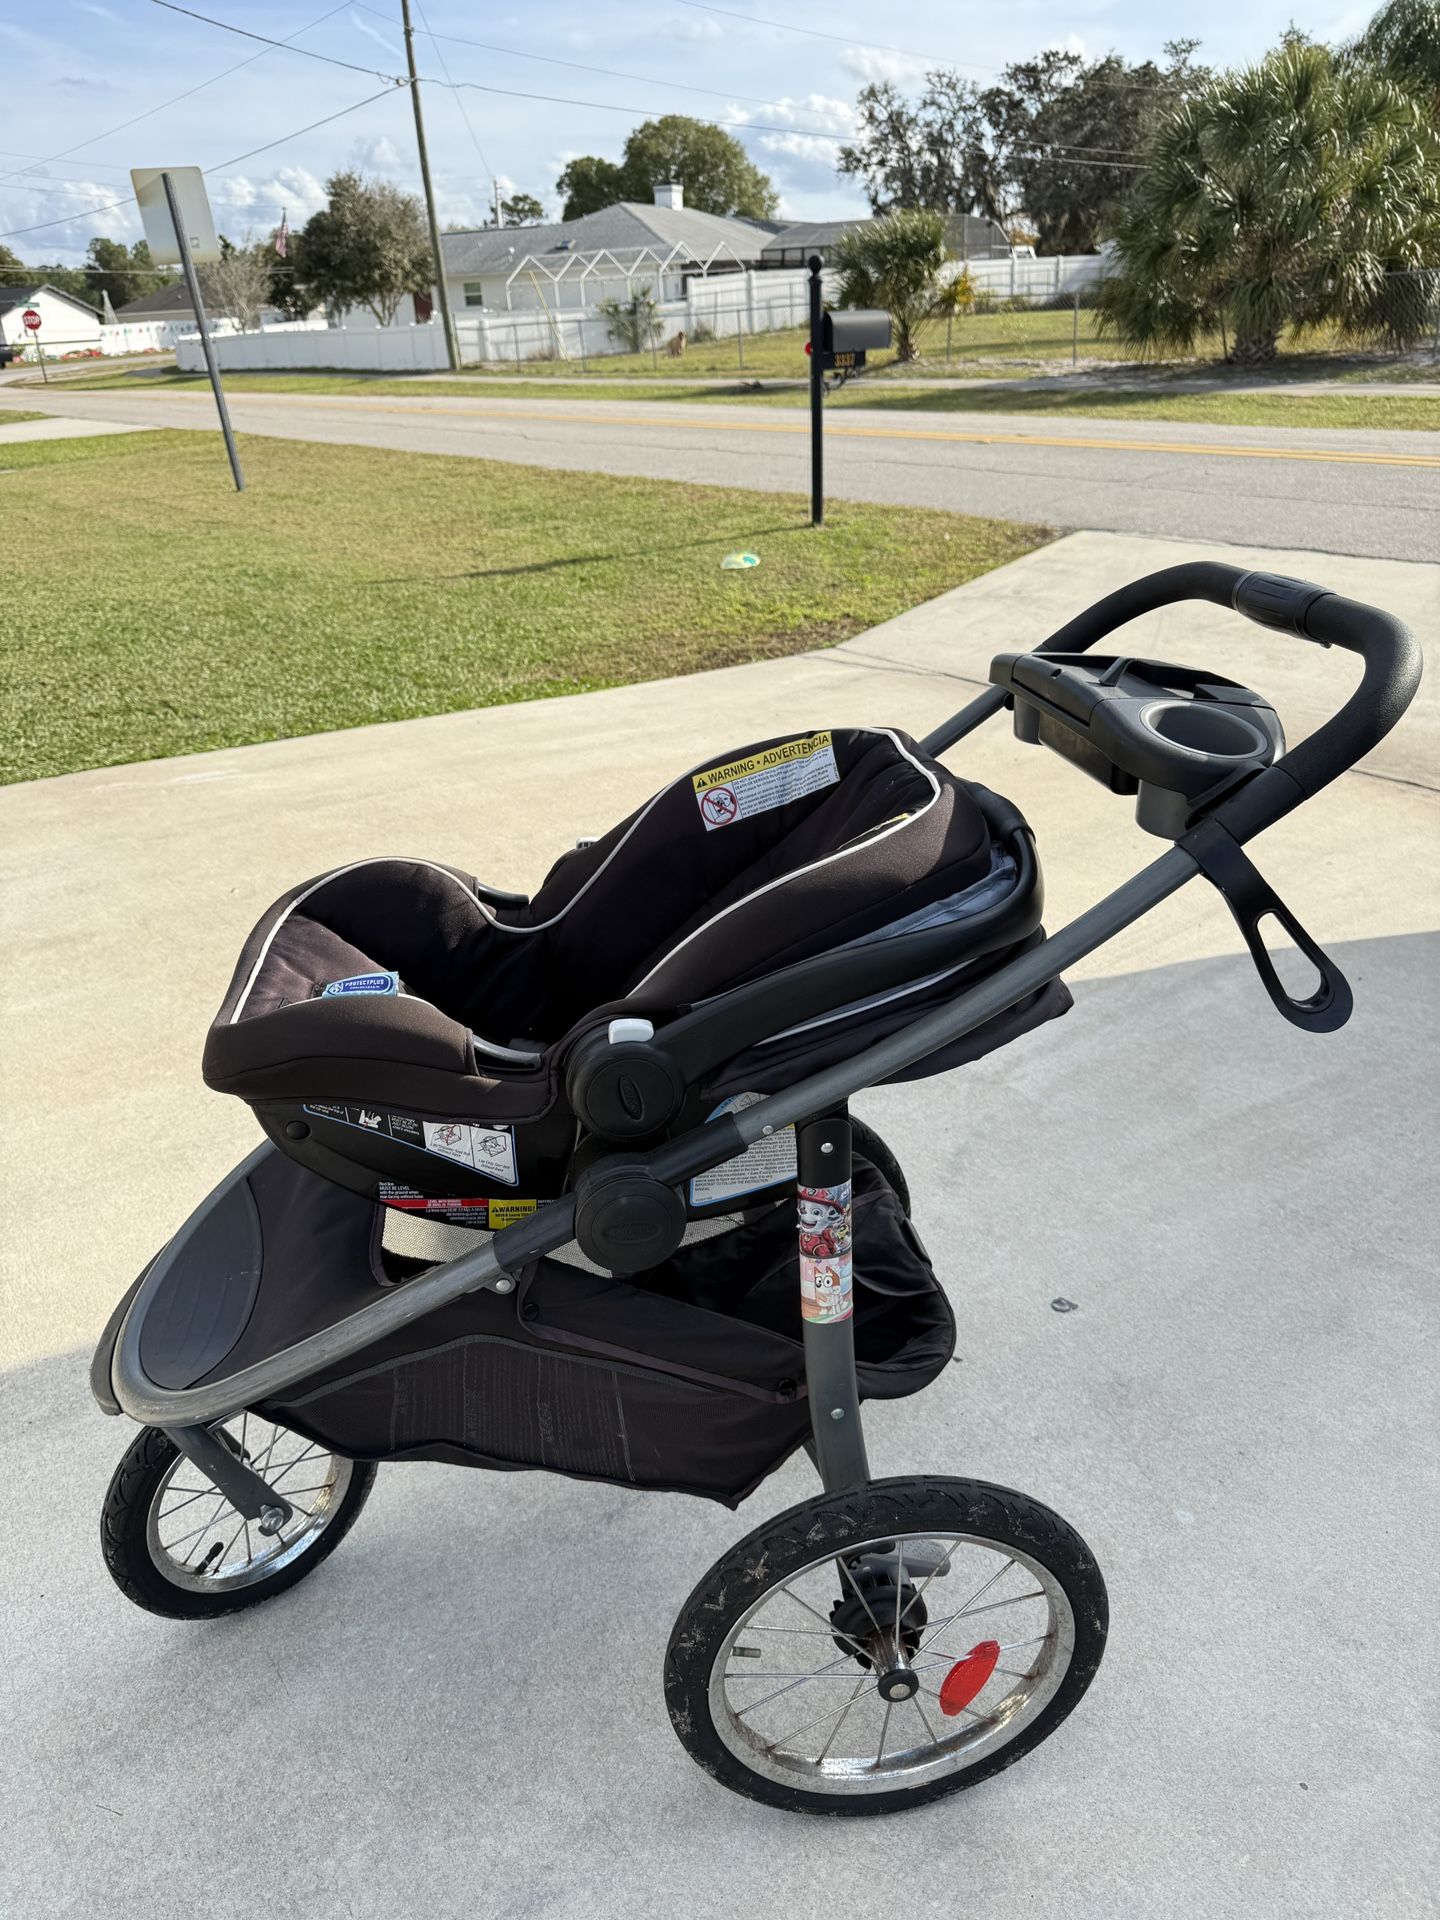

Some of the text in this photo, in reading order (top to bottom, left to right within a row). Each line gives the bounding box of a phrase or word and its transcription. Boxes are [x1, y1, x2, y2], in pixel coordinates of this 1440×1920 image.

[708, 761, 755, 783] WARNING
[763, 735, 829, 765] ADVERTENCIA
[345, 979, 384, 987] PROTECTPLUS
